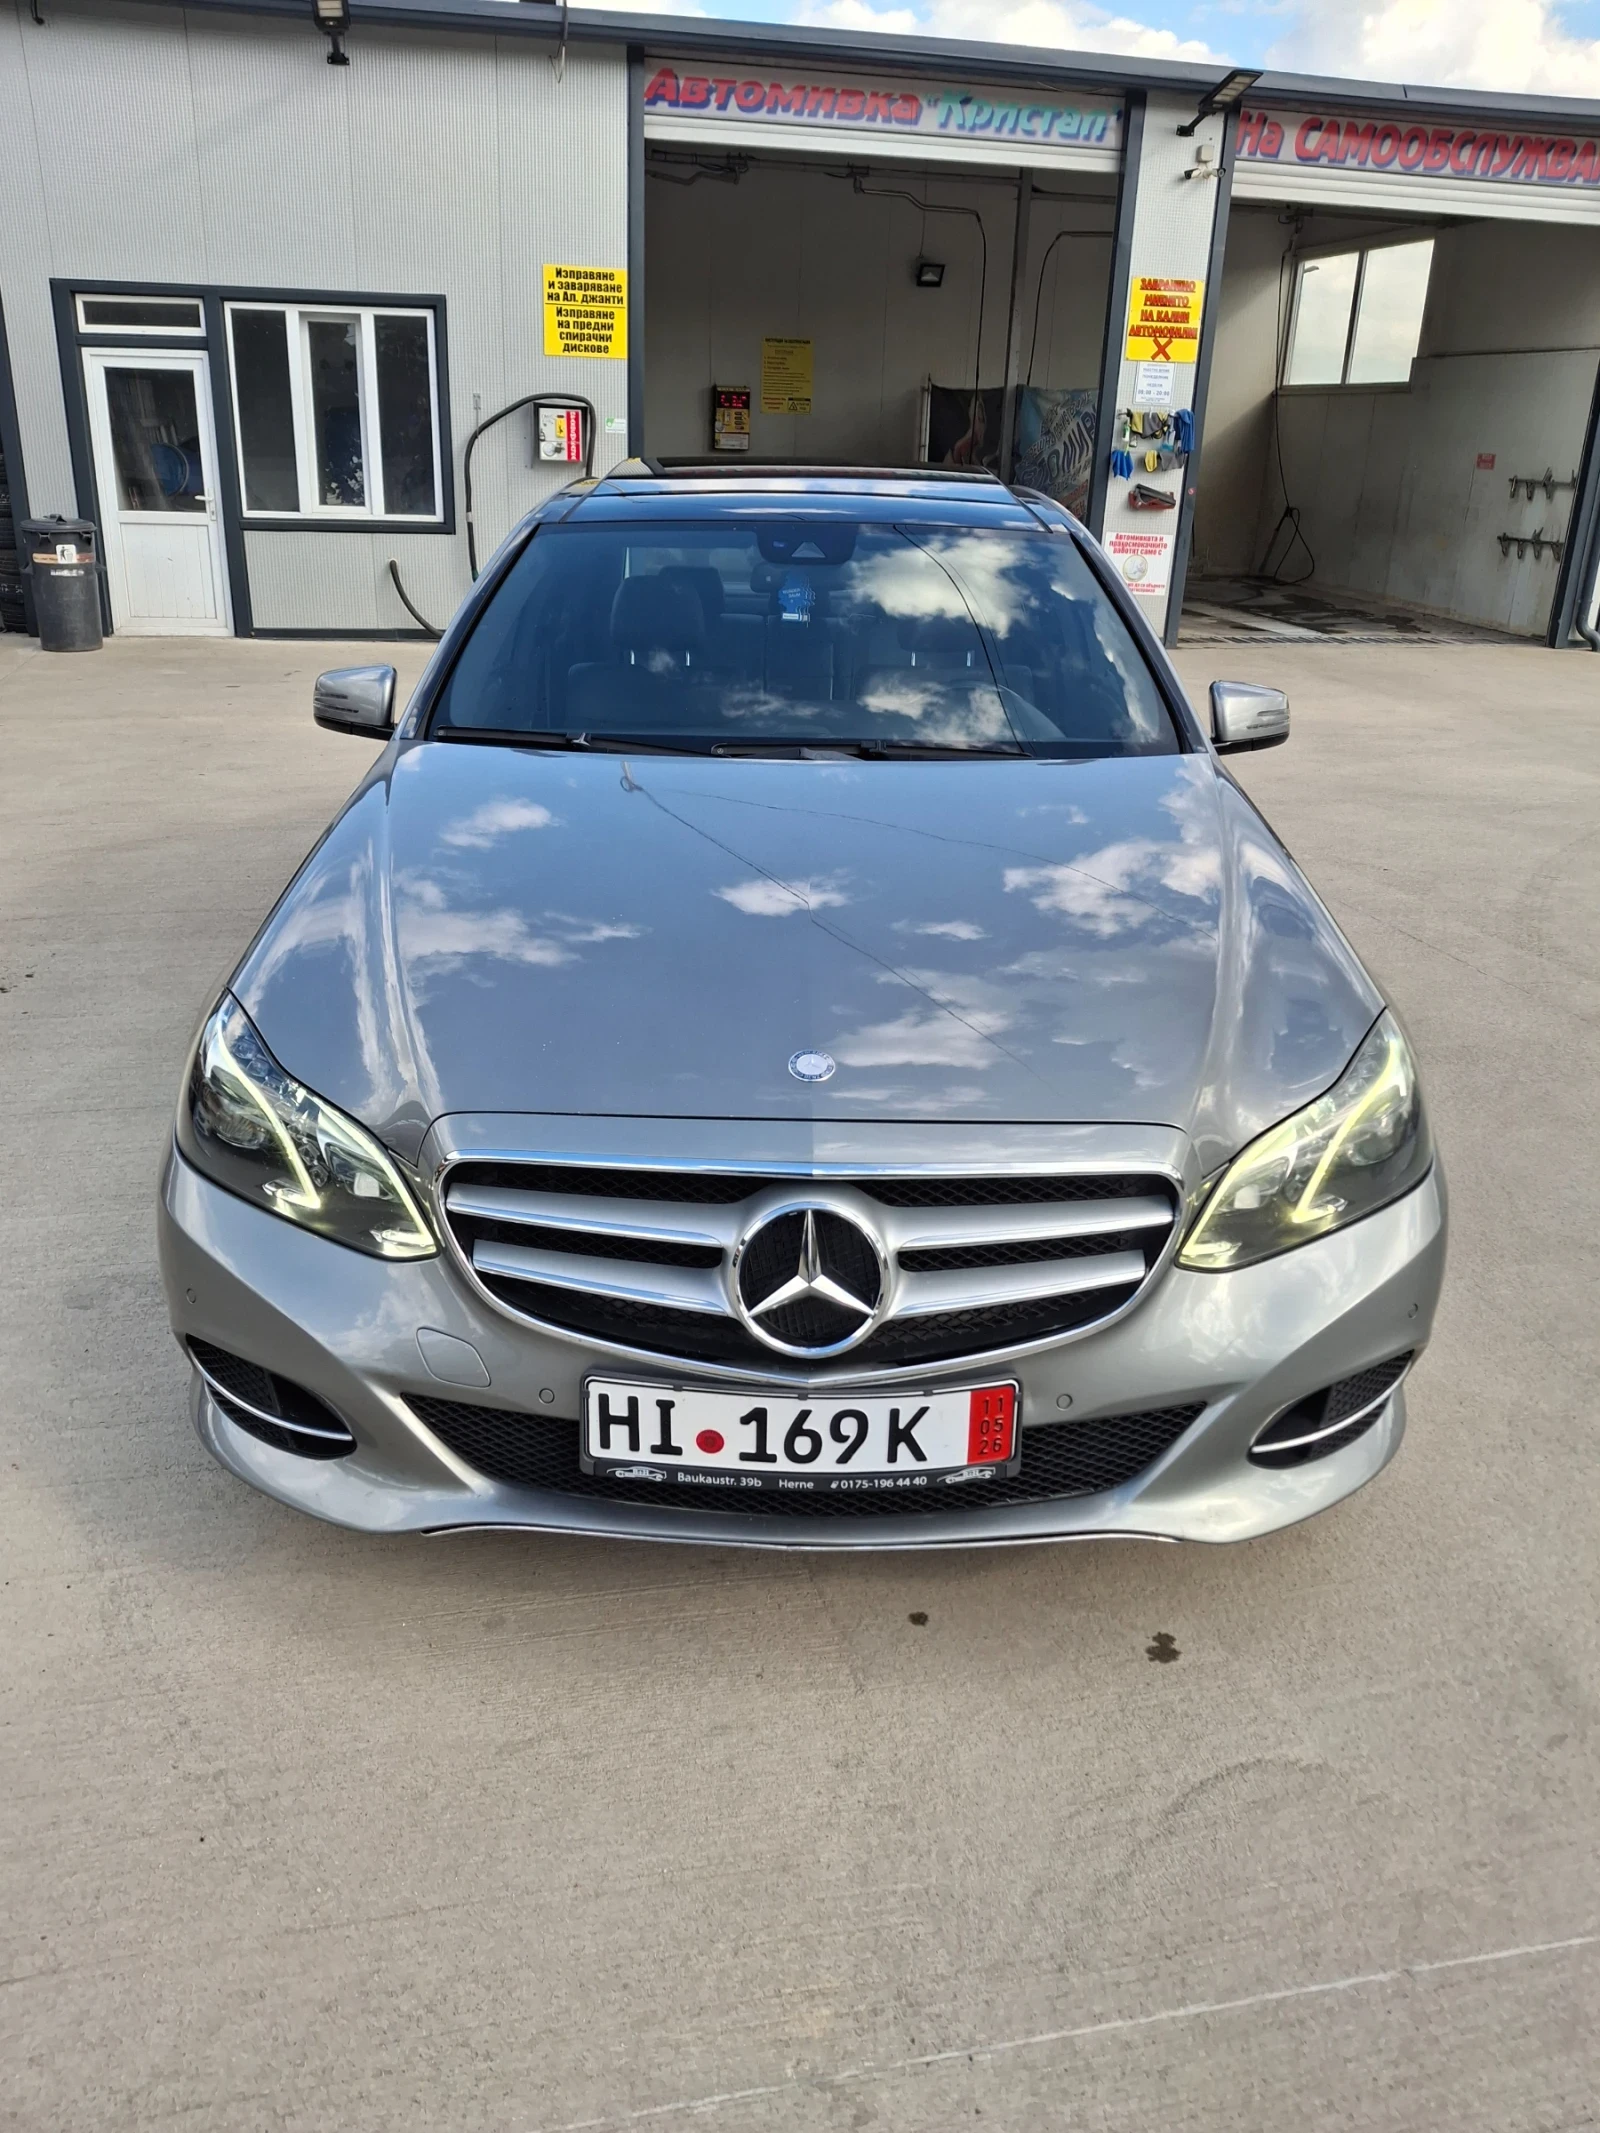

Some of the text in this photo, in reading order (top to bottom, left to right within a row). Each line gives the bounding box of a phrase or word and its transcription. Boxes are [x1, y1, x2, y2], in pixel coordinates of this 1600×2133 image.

[1236, 110, 1284, 159] На
[555, 267, 615, 281] Изправяне
[548, 280, 623, 293] и заваряване
[547, 292, 560, 301] на
[581, 294, 624, 305] джанти
[556, 306, 615, 320] Изправяне
[1140, 309, 1154, 322] НА
[557, 320, 614, 332] на предни
[559, 331, 613, 343] спирачни
[562, 343, 609, 354] дискове
[983, 1396, 1004, 1415] 11
[599, 1393, 931, 1465] HI 169 K
[980, 1416, 1004, 1435] 05
[977, 1436, 1002, 1455] 26
[677, 1472, 928, 1490] Baukaustr. 39b Herne 0175-196 44 40
